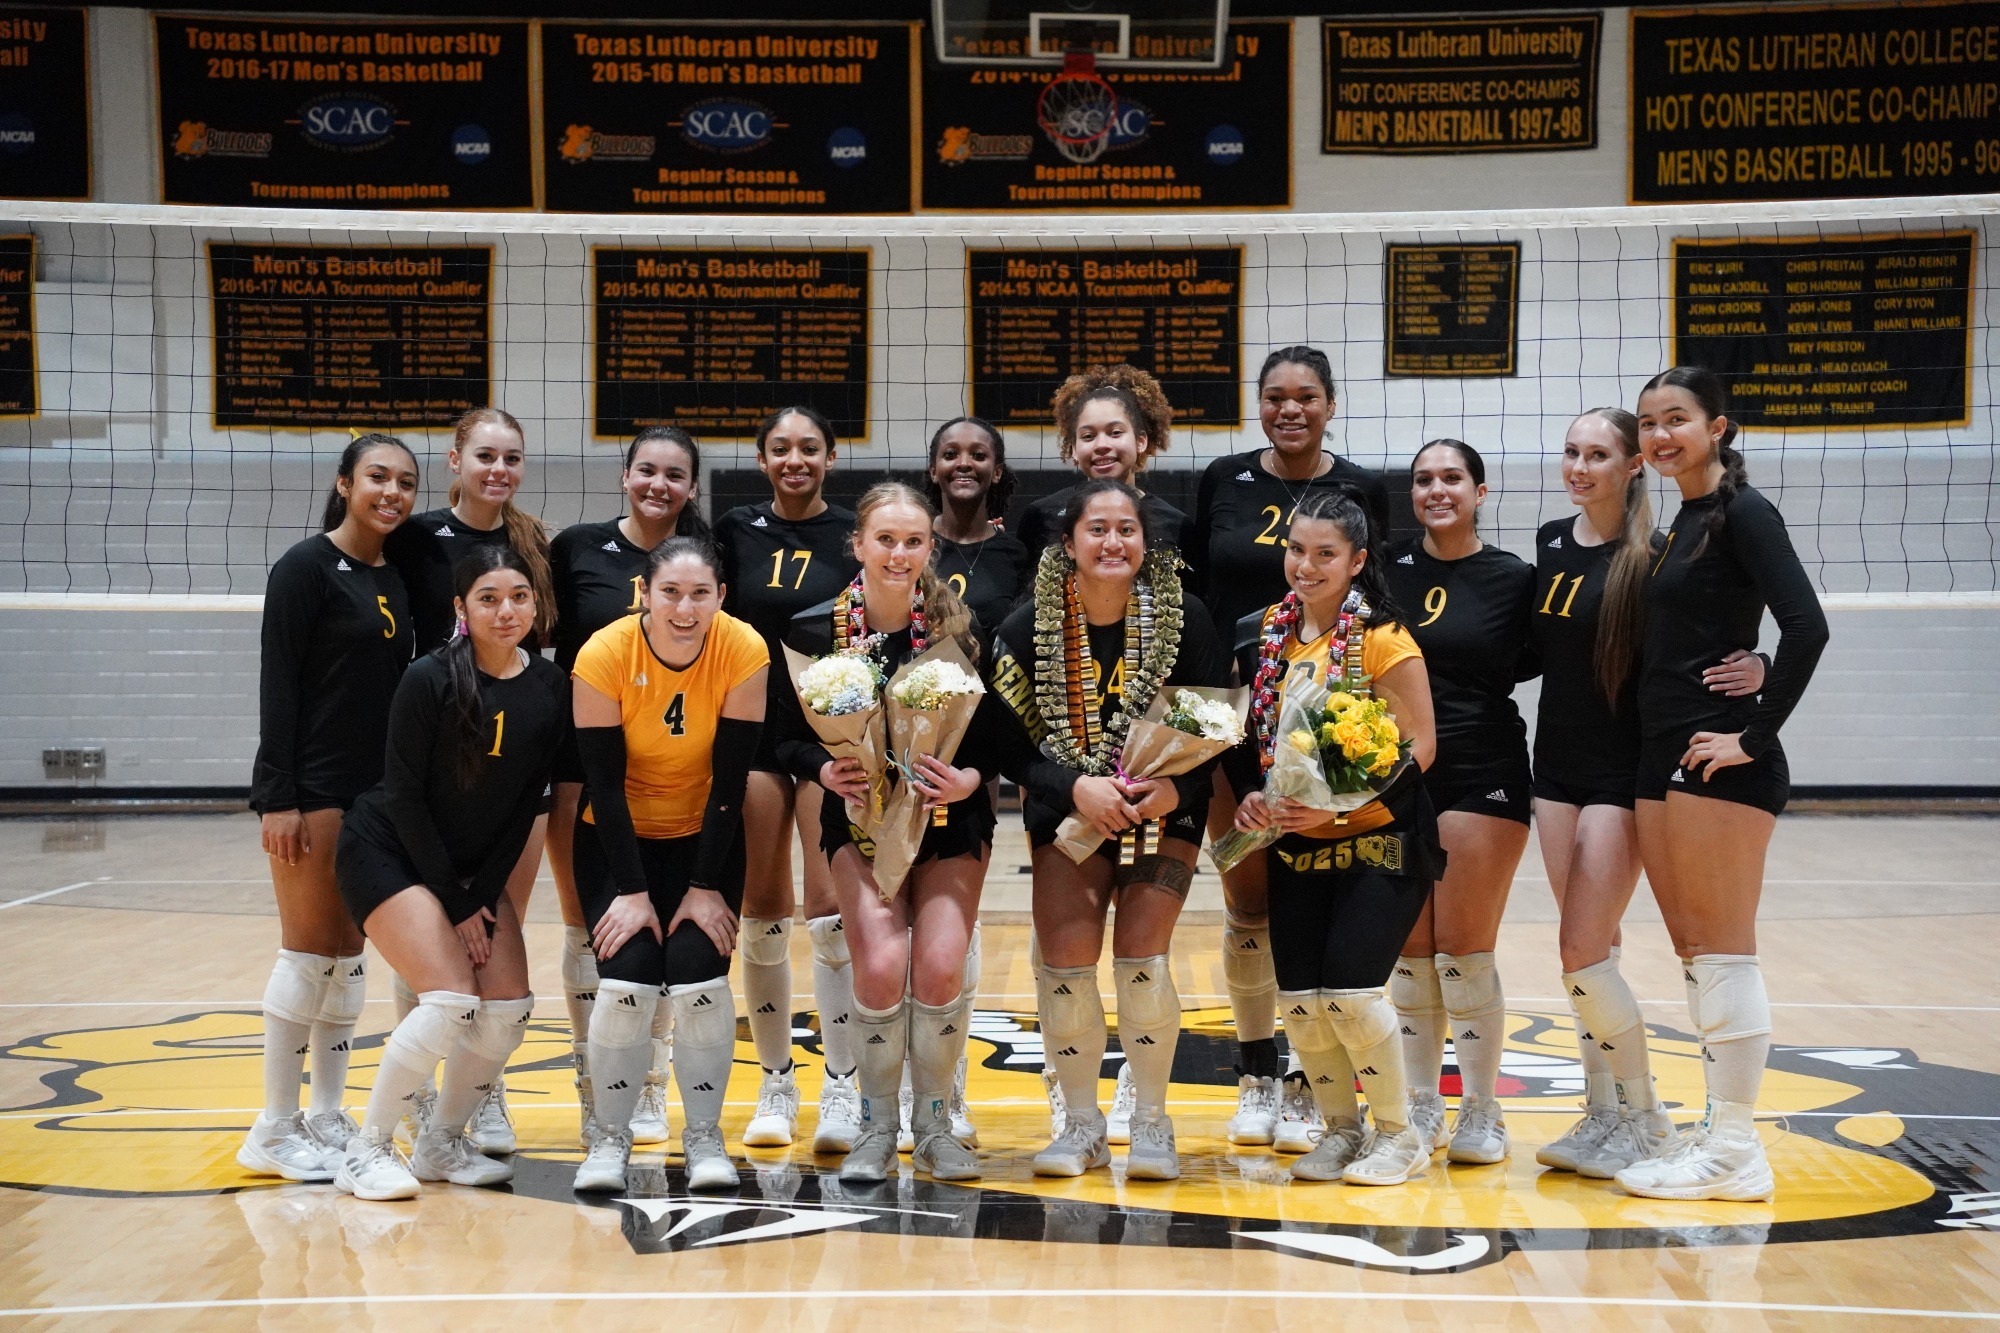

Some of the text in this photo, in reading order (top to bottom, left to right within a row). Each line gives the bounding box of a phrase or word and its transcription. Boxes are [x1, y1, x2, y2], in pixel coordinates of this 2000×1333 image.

[185, 28, 501, 56] Texas Lutheran University
[574, 34, 878, 59] Texas Lutheran University
[1136, 34, 1258, 57] Univerty
[1338, 26, 1583, 59] Texas Lutheran University
[1665, 26, 1999, 73] TEXAS LUTHERAN COLLEGE
[208, 59, 483, 82] 2016-17 Men's Basketball
[592, 62, 862, 83] 2015-16 Men's Basketball
[1339, 78, 1581, 103] HOT CONFERENCE CO-CHAMPS
[1646, 82, 2000, 131] HOT CONFERENCE CO-CHAMP
[308, 107, 389, 134] SCAC
[687, 111, 767, 139] SCAC
[1065, 109, 1146, 137] SCAC
[1335, 106, 1582, 142] MEN'S BASKETBALL 1997-98
[0, 130, 35, 143] NCAA
[454, 143, 491, 155] NCAA
[831, 146, 866, 158] NCAA
[1208, 143, 1243, 155] NCAA
[1657, 149, 1728, 186] MEN'S
[1735, 143, 1892, 182] BASKETBALL
[1901, 141, 1952, 176] 1995
[1975, 139, 2000, 174] 96
[658, 168, 723, 184] Regular
[725, 169, 785, 184] Season
[1035, 165, 1099, 181] Regular
[1102, 165, 1161, 180] Season
[251, 182, 449, 199] Tournament Champions
[632, 188, 826, 204] Tournament Champions
[1009, 184, 1201, 200] Tournament Champions
[253, 255, 442, 276] Men's Basketball
[636, 259, 821, 279] Men's Basketball
[1007, 258, 1198, 280] Men's Basketball
[1689, 262, 1713, 275] ERIC
[1786, 258, 1864, 274] CHRIS FREITAG
[1875, 255, 1957, 270] JERALD REINER
[219, 277, 483, 296] 2016-17 NCAA Tournament Qualifier
[603, 282, 861, 299] 2015-16 NCAA Tournament Qualifier
[979, 278, 1232, 297] 2014-15 NCAA Tournament Qualifier
[1688, 281, 1769, 295] BRIAN CADDELL
[1786, 279, 1861, 294] NED HARDMAN
[1875, 275, 1953, 290] WILLIAM SMITH
[1688, 301, 1762, 316] JOHN CROOKS
[1787, 300, 1851, 315] JOSH JONES
[1874, 297, 1901, 311] CORY
[1688, 323, 1725, 336] ROGER
[1788, 320, 1852, 334] KEVIN LEWIS
[1873, 315, 1961, 332] SHANE WILLIAMS
[1788, 340, 1865, 355] TREY PRESTON
[1752, 363, 1769, 375] JIM
[1822, 361, 1848, 373] HEAD
[1851, 360, 1888, 373] COACH
[1763, 383, 1803, 396] PHELPS
[1811, 381, 1868, 395] ASSISTANT
[1870, 380, 1907, 393] COACH
[1830, 401, 1875, 414] TRAINER
[767, 549, 812, 590] 17
[1539, 571, 1585, 617] 11
[1418, 586, 1447, 627] 9
[377, 595, 396, 638] 5
[989, 653, 1051, 748] SENIOR
[661, 691, 685, 736] 4
[488, 710, 504, 757] 1
[1278, 840, 1352, 872] 2025
